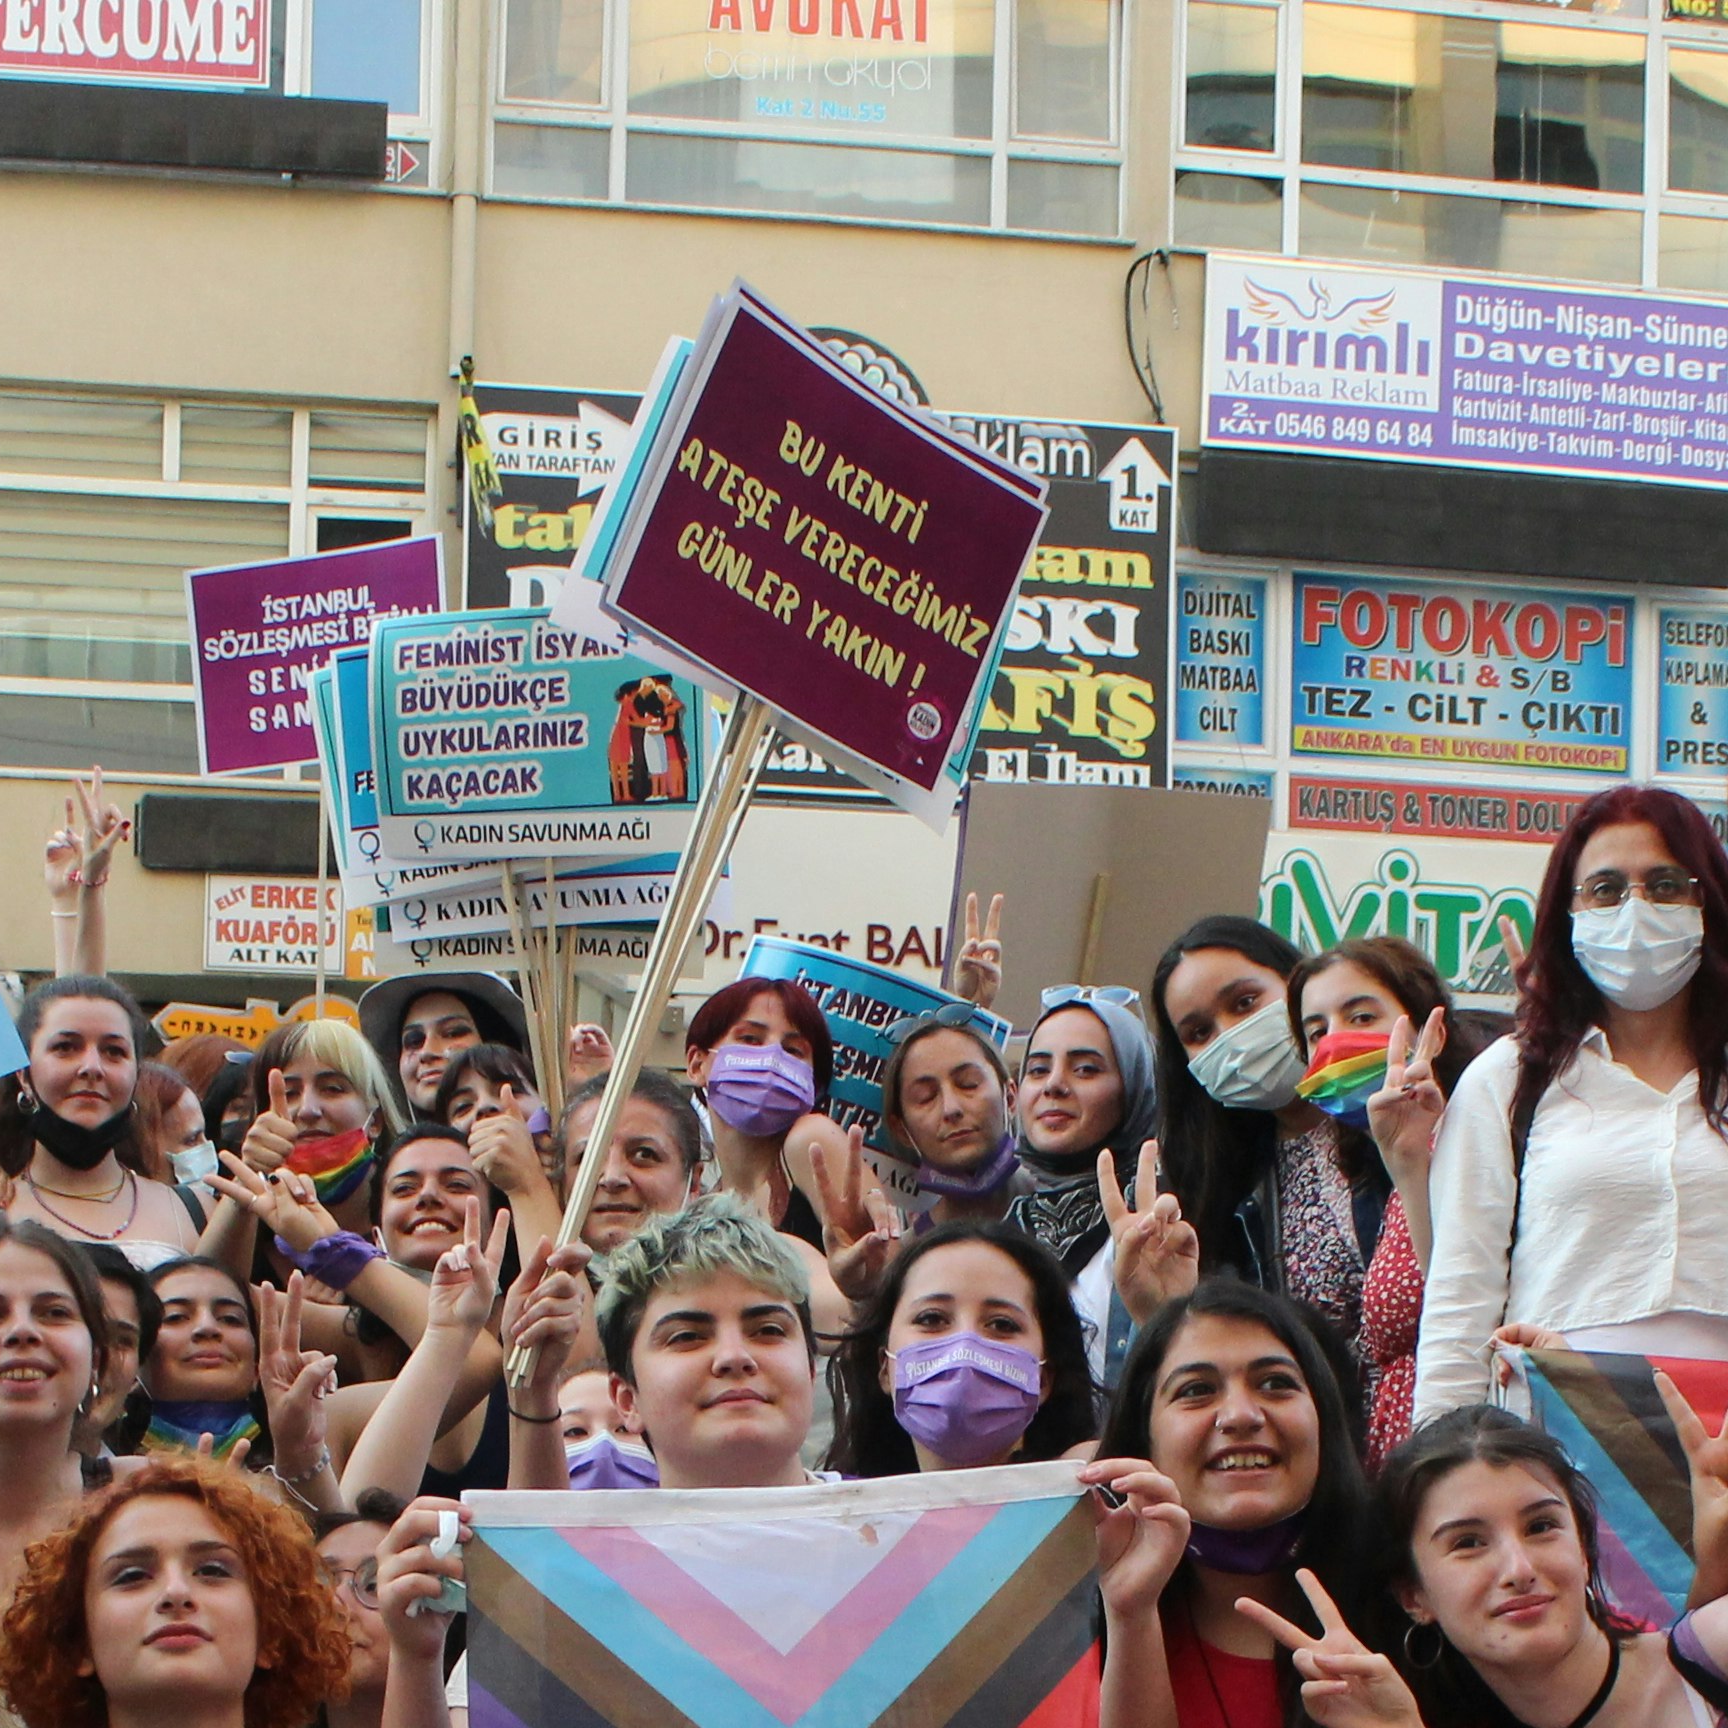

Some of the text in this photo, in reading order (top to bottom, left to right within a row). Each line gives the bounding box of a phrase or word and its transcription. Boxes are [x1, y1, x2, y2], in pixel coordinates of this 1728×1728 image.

[756, 96, 793, 117] Kat
[801, 98, 814, 118] 2
[1224, 369, 1428, 408] Matbaa Reklam
[1218, 411, 1433, 448] KAT 0546 849 64 84
[1232, 403, 1256, 419] 2.
[497, 420, 603, 455] GİRİŞ
[972, 419, 1093, 480] klam
[778, 419, 929, 545] BU KENTİ
[1119, 464, 1154, 503] 1.
[1118, 508, 1150, 529] KAT
[677, 437, 991, 659] ATEŞE VERECEĞİMİZ
[261, 584, 377, 625] İSTANBUL
[676, 521, 801, 626] GÜNLER
[805, 599, 907, 688] YAKIN
[1183, 583, 1256, 620] DİJİTAL
[203, 613, 350, 663] SÖZLEŞMESİ
[399, 630, 524, 671] FEMİNİST
[1189, 628, 1250, 655] BASKI
[401, 673, 566, 715] BÜYÜDÜKÇE
[1180, 662, 1257, 694] MATBAA
[1476, 666, 1501, 688] &
[1509, 666, 1572, 696] S/B
[1199, 700, 1238, 734] CİLT
[1302, 685, 1373, 718] TEZ
[1521, 701, 1620, 739] ÇIKTI
[1689, 701, 1709, 725] &
[403, 719, 584, 757] UYKULARINIZ
[1301, 729, 1519, 763] ANKARA'da EN UYGUN
[407, 766, 538, 804] KAÇACAK
[1297, 783, 1396, 832] KARTUŞ
[1401, 791, 1422, 823] &
[1427, 794, 1508, 832] TONER
[441, 816, 651, 844] KADIN SAVUNMA AĞI
[214, 885, 248, 912] ELİT
[436, 896, 508, 922] KADIN
[228, 948, 270, 964] ALT
[438, 936, 503, 958] KADIN
